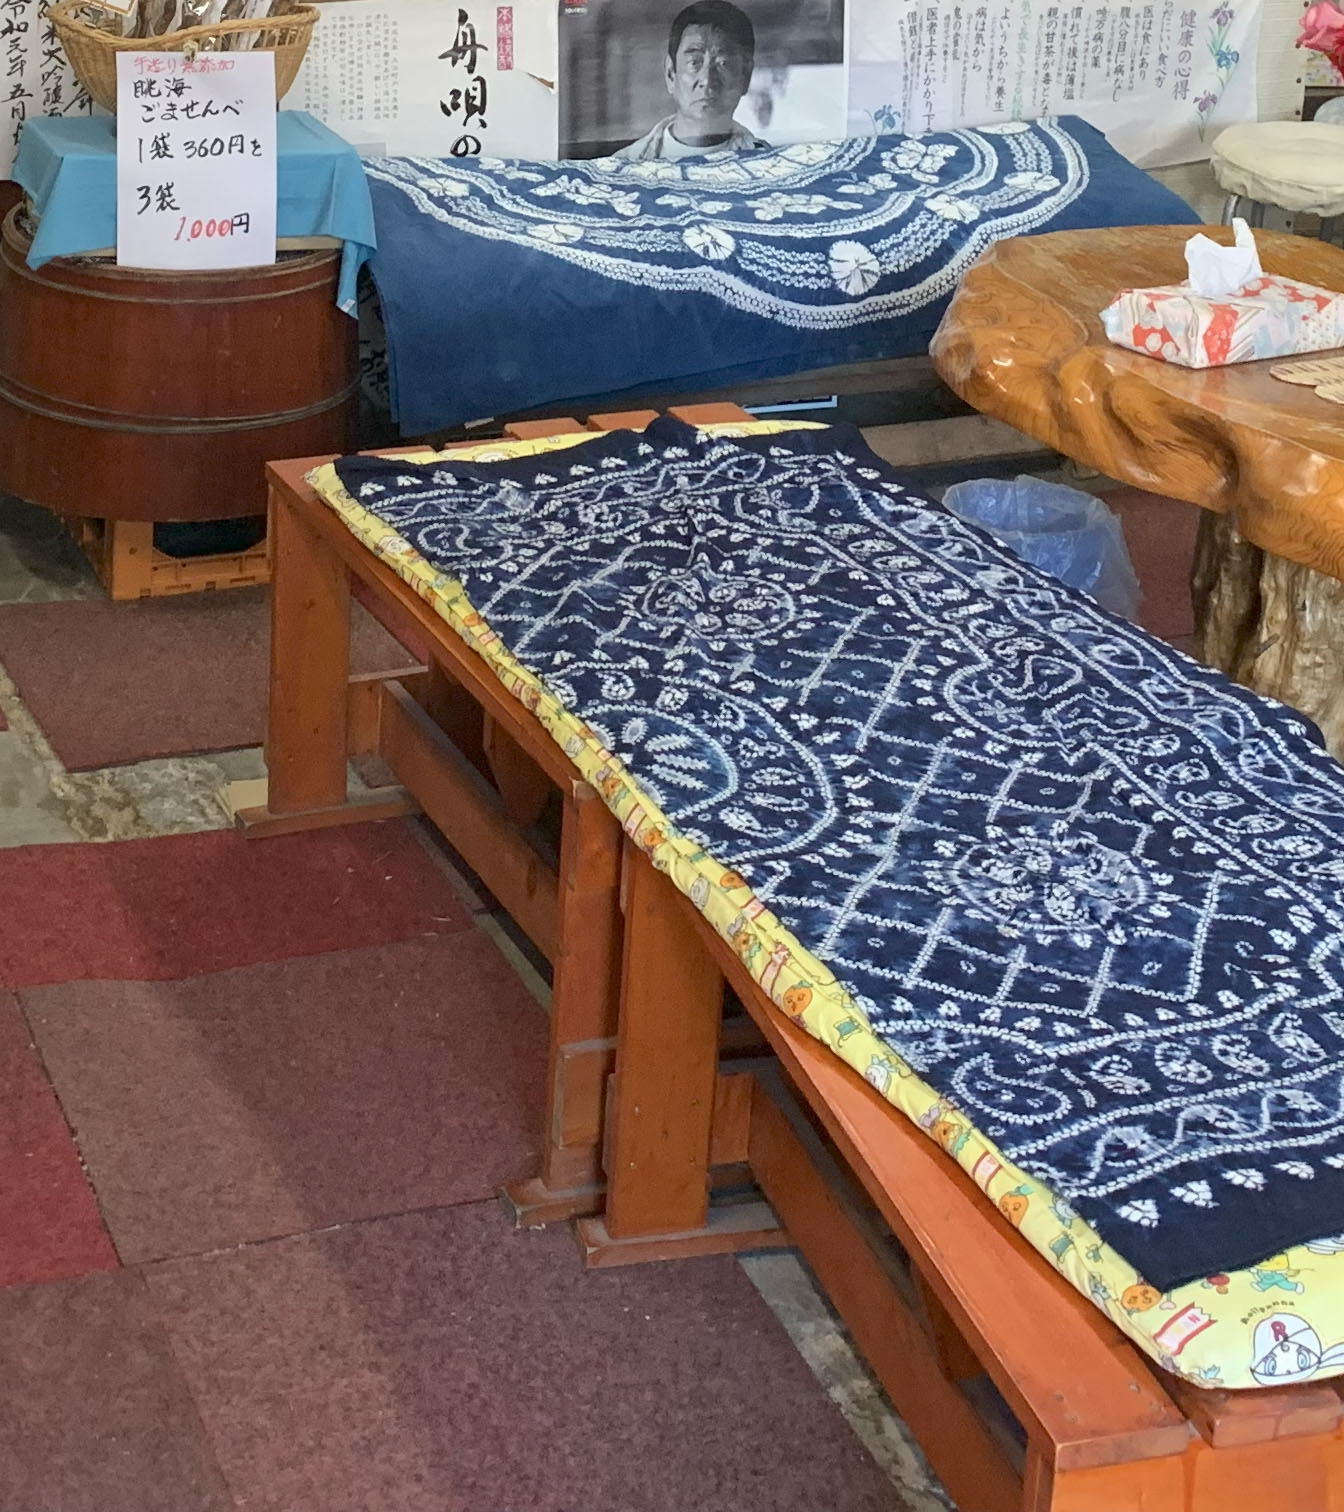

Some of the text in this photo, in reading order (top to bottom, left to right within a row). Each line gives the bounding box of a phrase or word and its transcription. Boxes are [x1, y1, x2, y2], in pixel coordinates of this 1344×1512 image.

[437, 7, 489, 158] 舟唄の
[1172, 8, 1197, 101] 健康の心得
[141, 99, 244, 123] ごませんべ
[136, 181, 181, 216] 3袋
